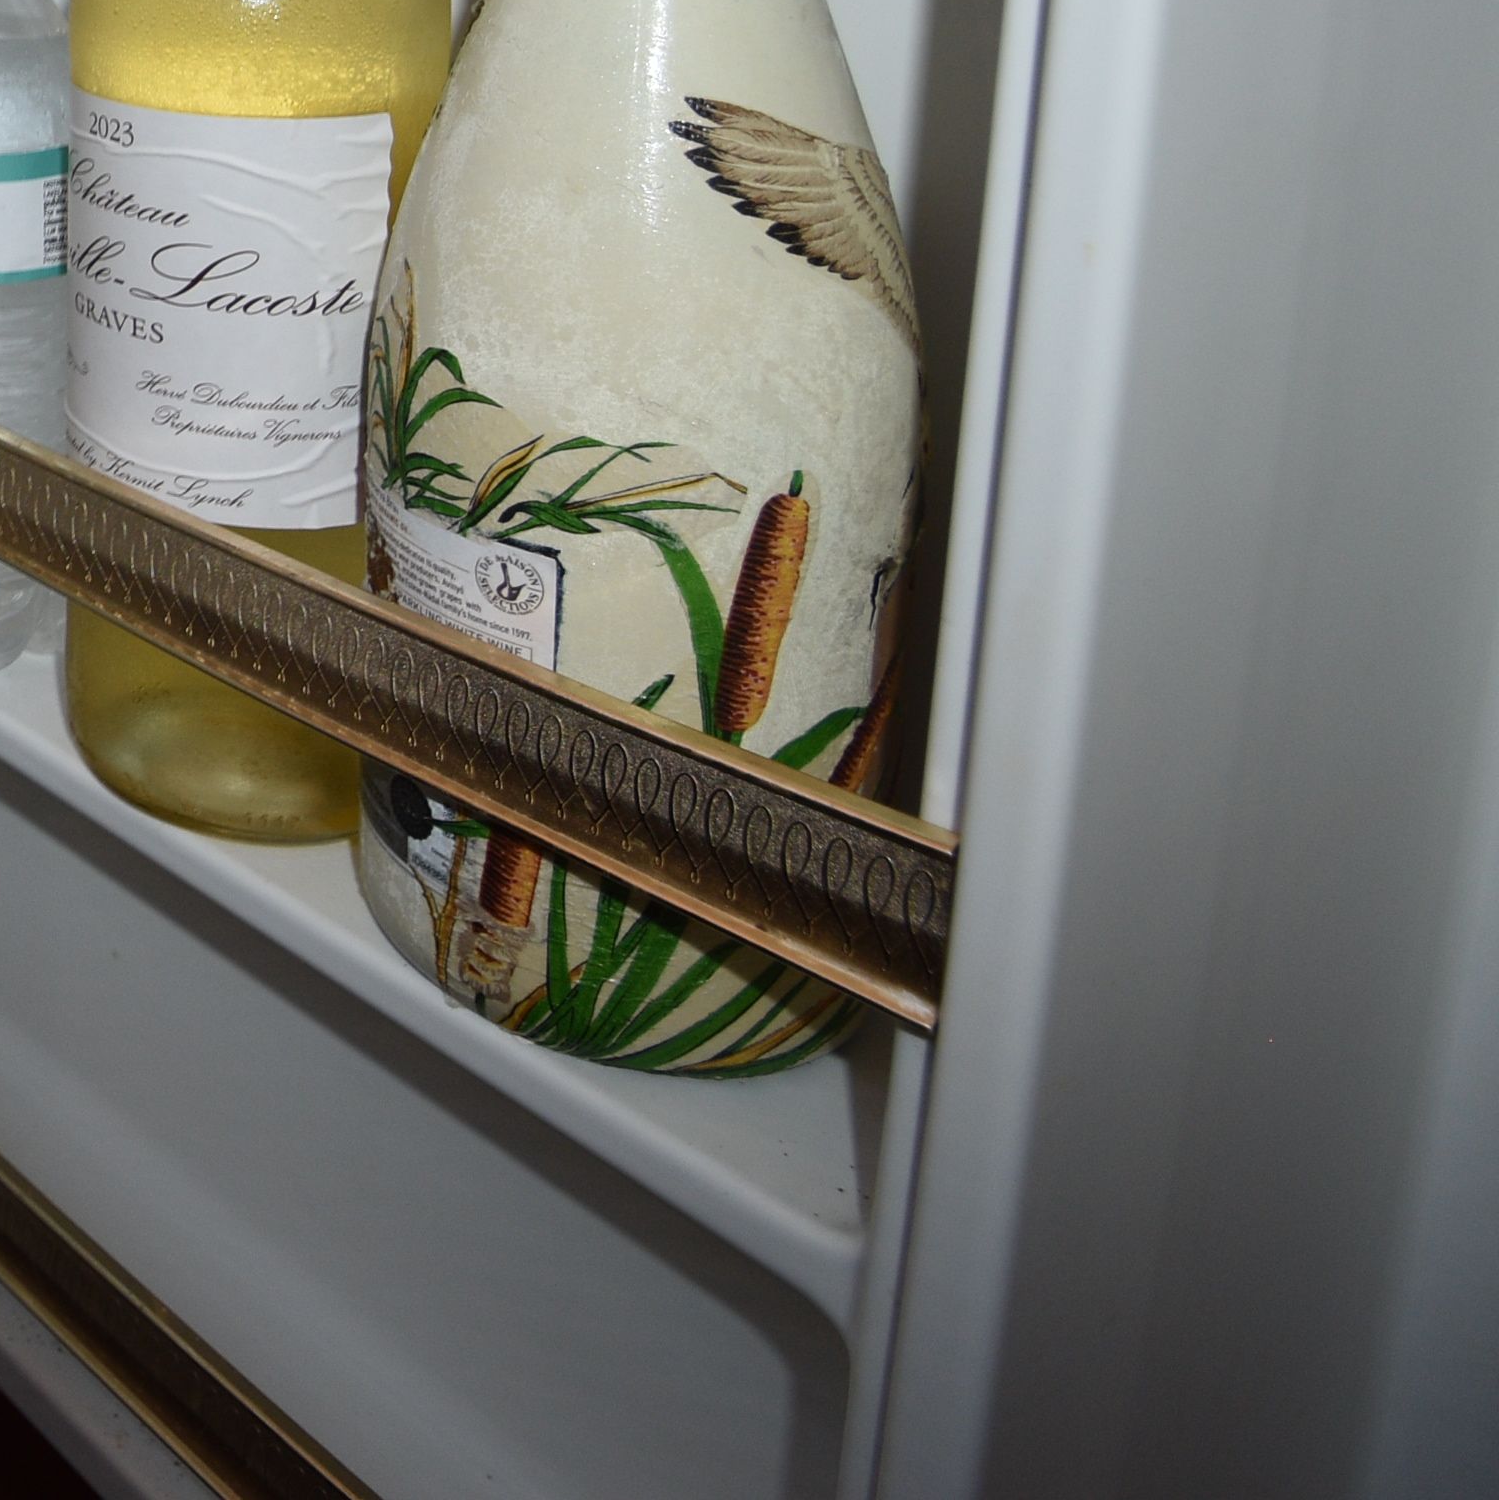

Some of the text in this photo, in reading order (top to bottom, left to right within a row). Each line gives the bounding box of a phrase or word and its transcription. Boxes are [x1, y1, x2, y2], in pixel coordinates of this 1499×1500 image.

[88, 111, 135, 148] 2023
[69, 156, 191, 228] Château
[67, 235, 364, 317] ille-Lacoste
[74, 291, 165, 345] GRAVES
[135, 369, 188, 402] Hervé
[191, 381, 300, 413] Dubourdieu
[301, 397, 319, 412] et
[151, 405, 341, 448] Propriétaires Vignerons
[99, 450, 165, 494] Kermit
[166, 474, 254, 509] Lynch
[479, 554, 540, 587] DE MAISON
[477, 576, 541, 612] SELECTIONS
[486, 636, 524, 657] WINE
[489, 621, 510, 635] since
